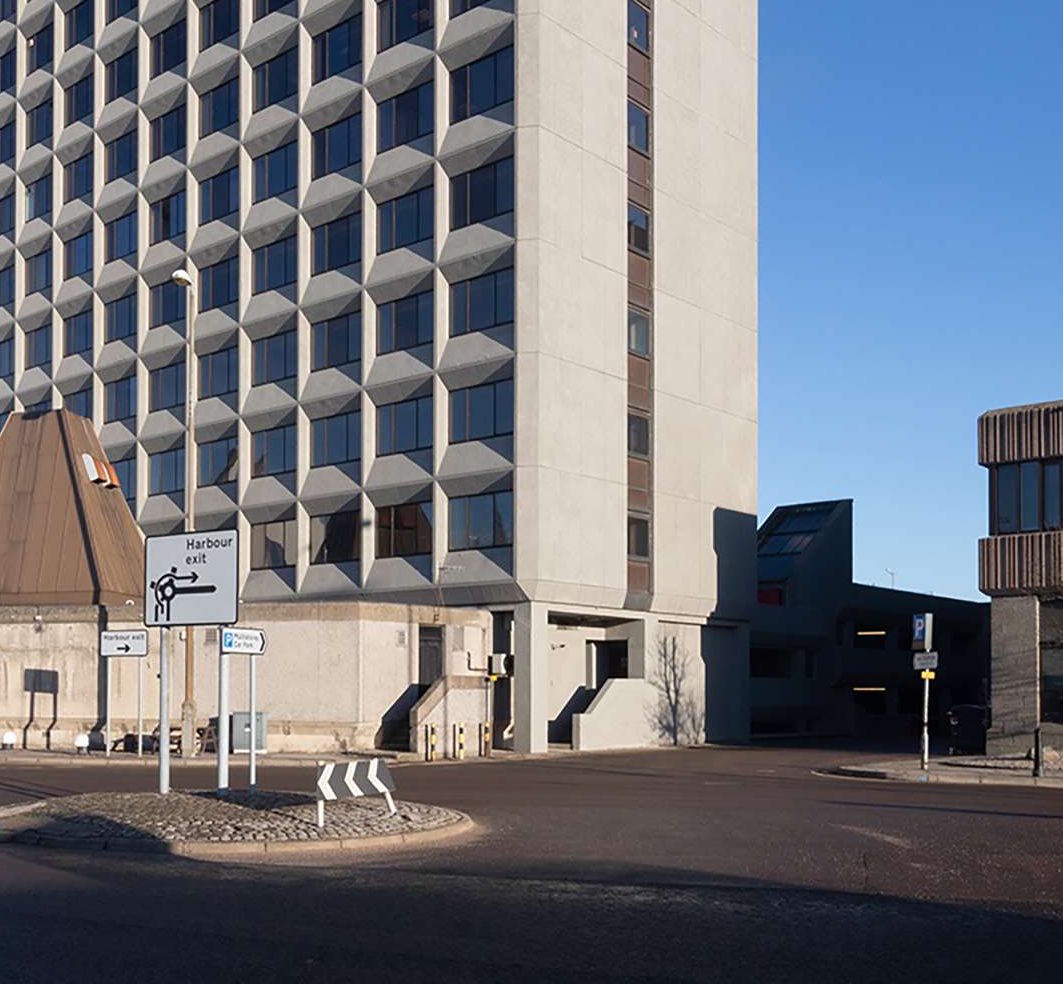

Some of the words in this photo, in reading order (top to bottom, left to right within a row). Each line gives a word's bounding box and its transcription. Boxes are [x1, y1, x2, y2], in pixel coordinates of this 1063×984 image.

[186, 537, 233, 550] Harbour
[185, 552, 207, 565] exit
[131, 633, 146, 641] exit
